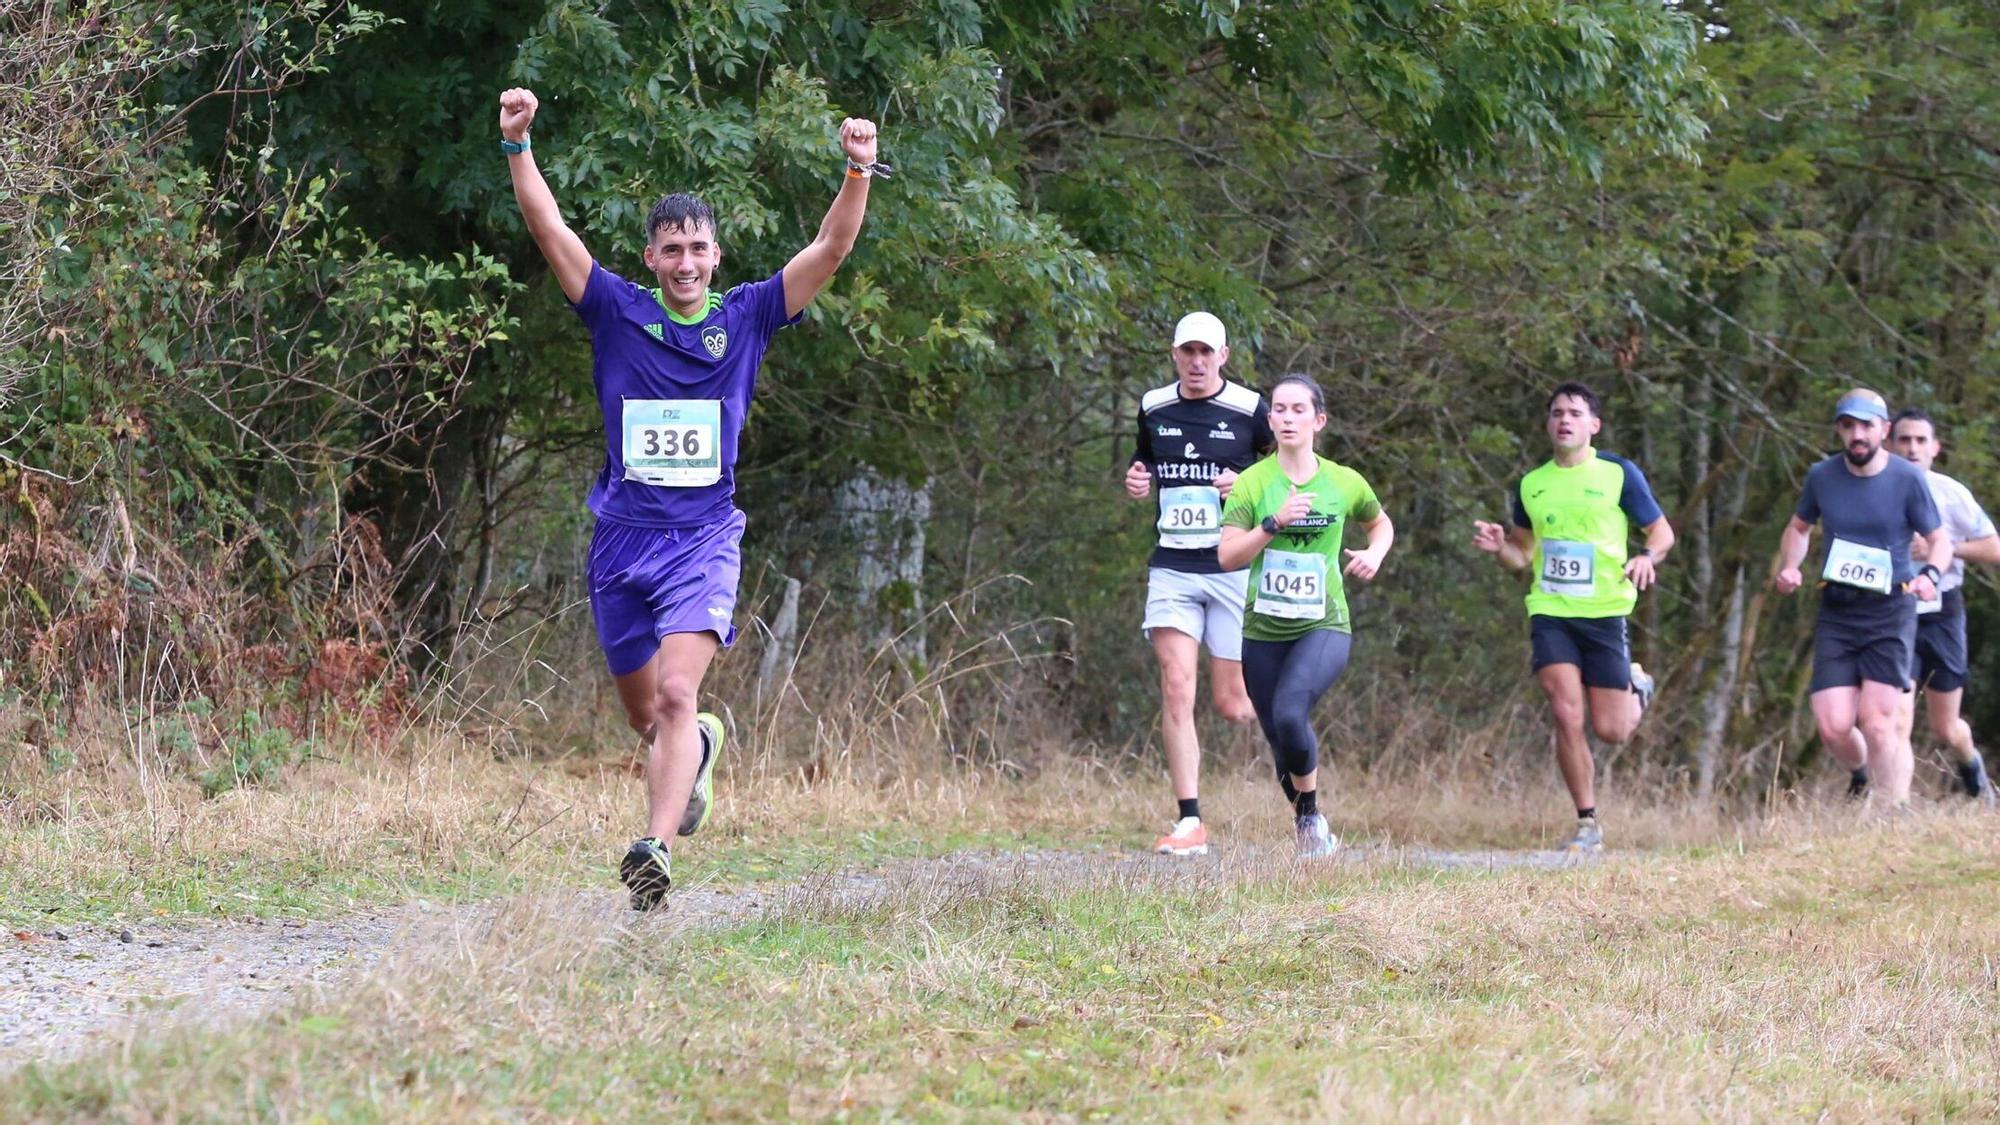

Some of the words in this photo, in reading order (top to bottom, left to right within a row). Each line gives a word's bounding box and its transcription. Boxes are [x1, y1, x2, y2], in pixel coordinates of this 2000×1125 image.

[644, 429, 700, 456] 336
[1157, 461, 1220, 480] etxenik
[1171, 508, 1207, 526] 304
[1550, 558, 1580, 577] 369
[1840, 562, 1876, 583] 606
[1264, 572, 1315, 595] 1045
